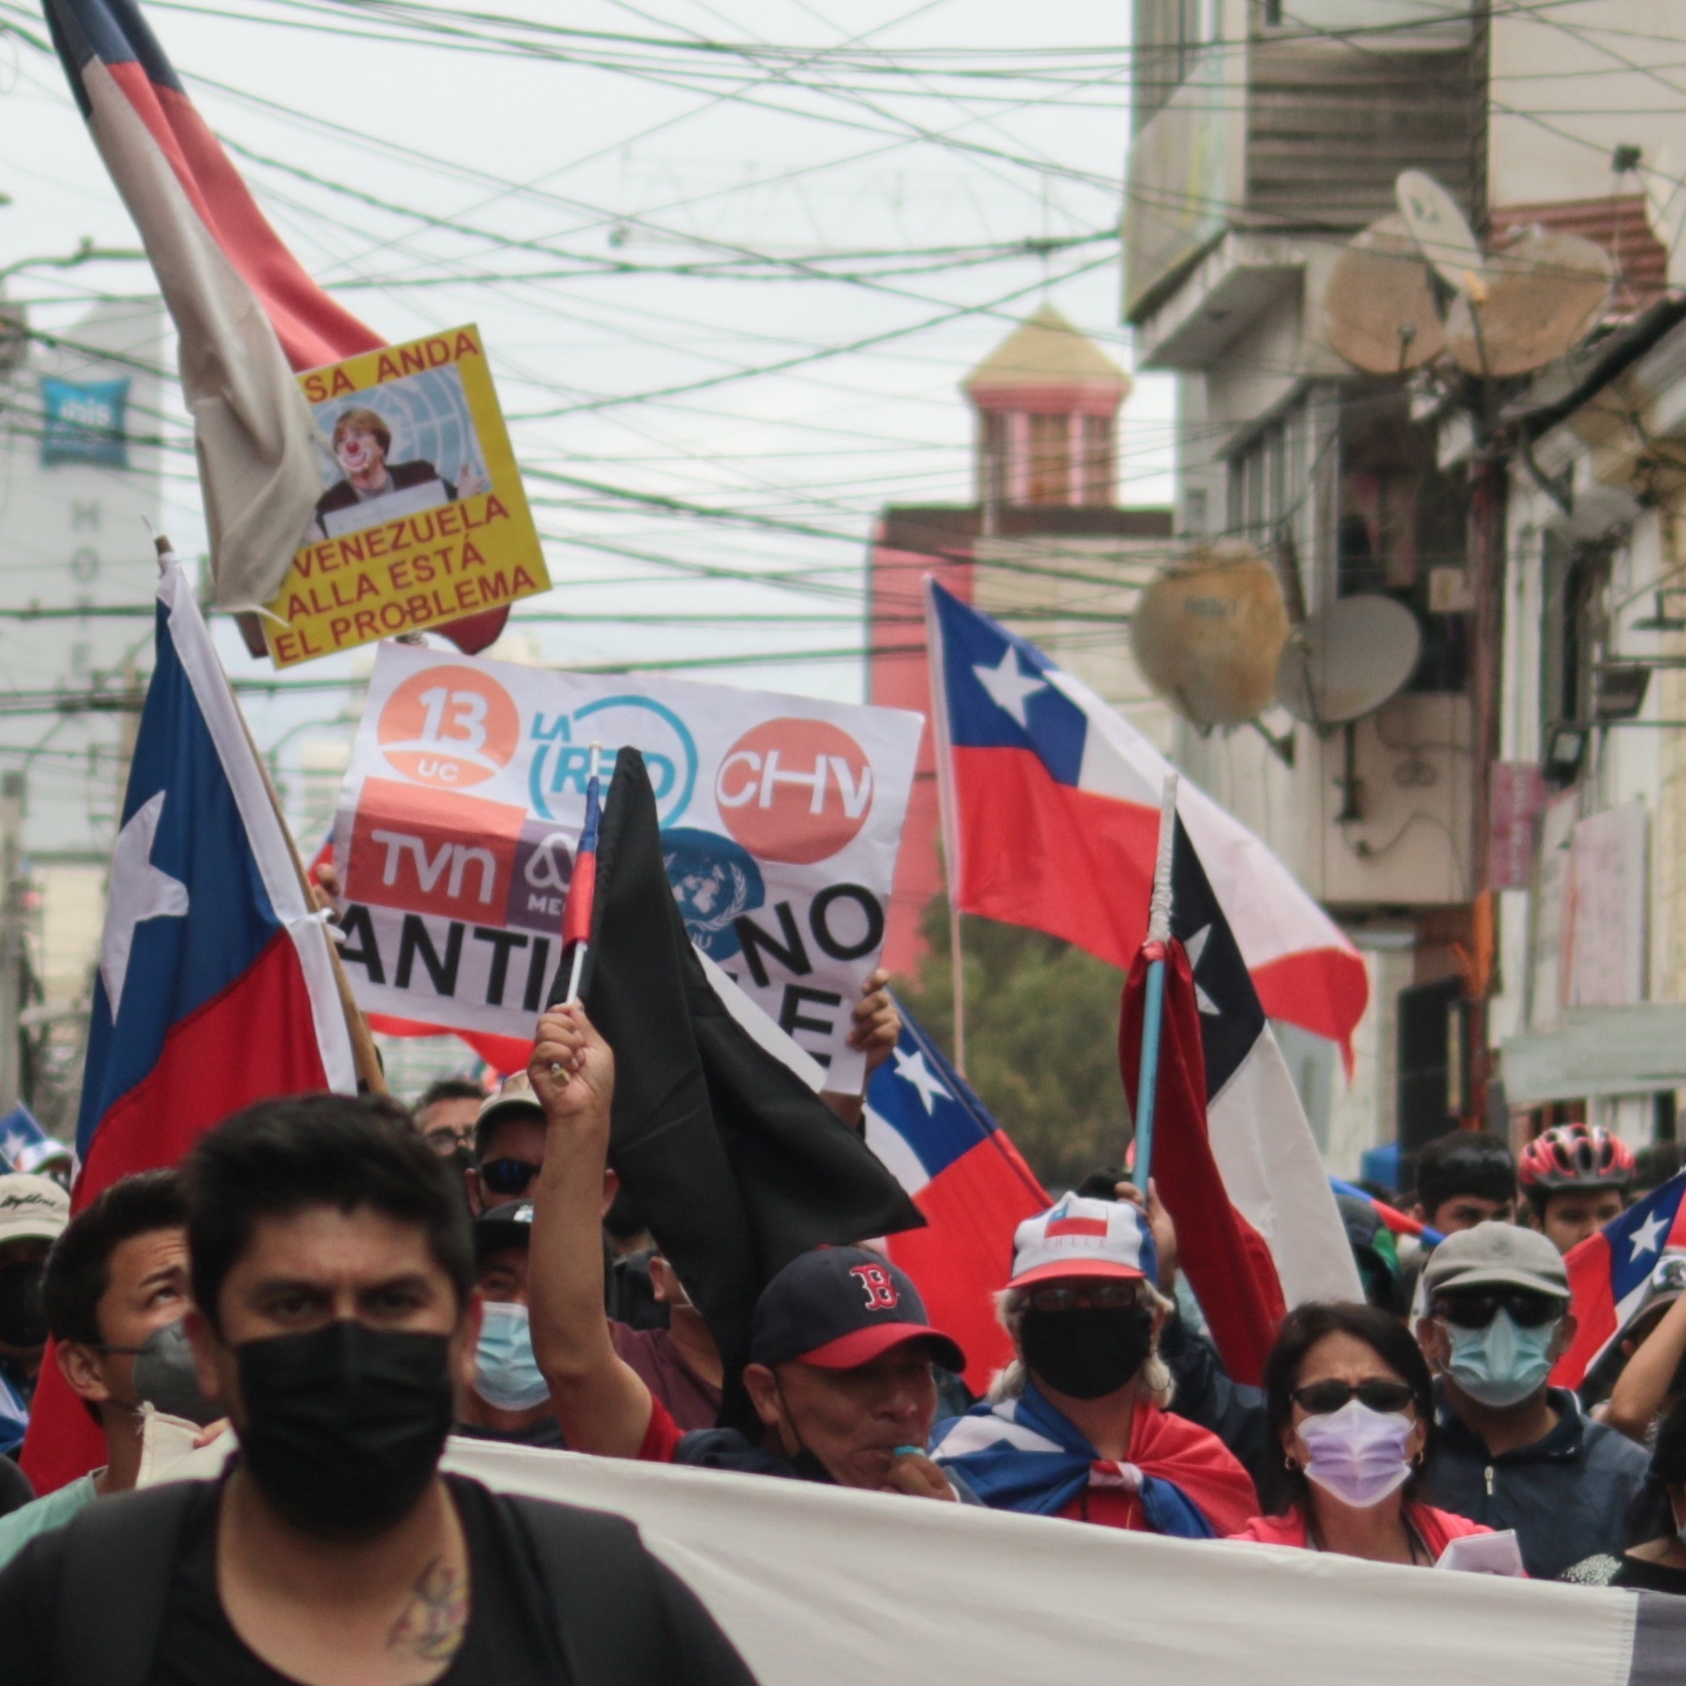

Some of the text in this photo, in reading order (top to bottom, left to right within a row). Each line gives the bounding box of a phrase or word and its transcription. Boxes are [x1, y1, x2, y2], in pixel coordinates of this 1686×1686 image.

[376, 330, 480, 384] ANDA
[292, 493, 511, 580] VENEZUELA
[285, 532, 487, 623] ALLA ESTÁ
[274, 563, 538, 665] EL PROBLEMA
[418, 686, 489, 752] 13
[530, 711, 572, 743] LA
[417, 759, 460, 782] UC
[714, 749, 873, 820] CHV
[849, 1263, 900, 1311] B
